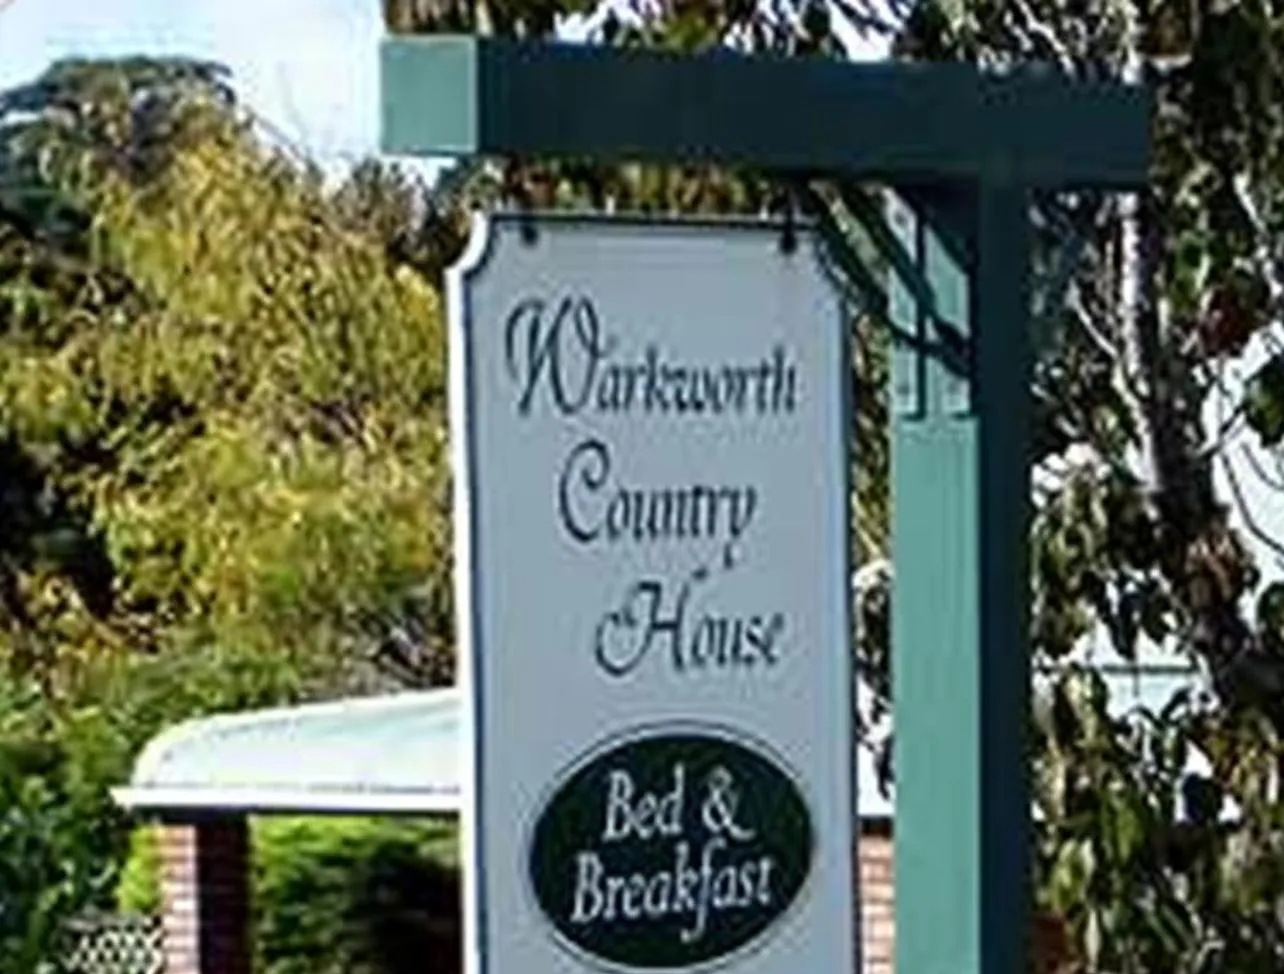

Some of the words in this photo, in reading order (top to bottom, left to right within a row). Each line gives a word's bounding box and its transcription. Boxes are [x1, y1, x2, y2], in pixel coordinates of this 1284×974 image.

[505, 295, 796, 417] Warkworth
[559, 438, 757, 568] Country
[595, 570, 784, 677] House
[602, 762, 686, 841] Bed
[701, 765, 756, 840] &
[570, 837, 774, 942] Breakfast
